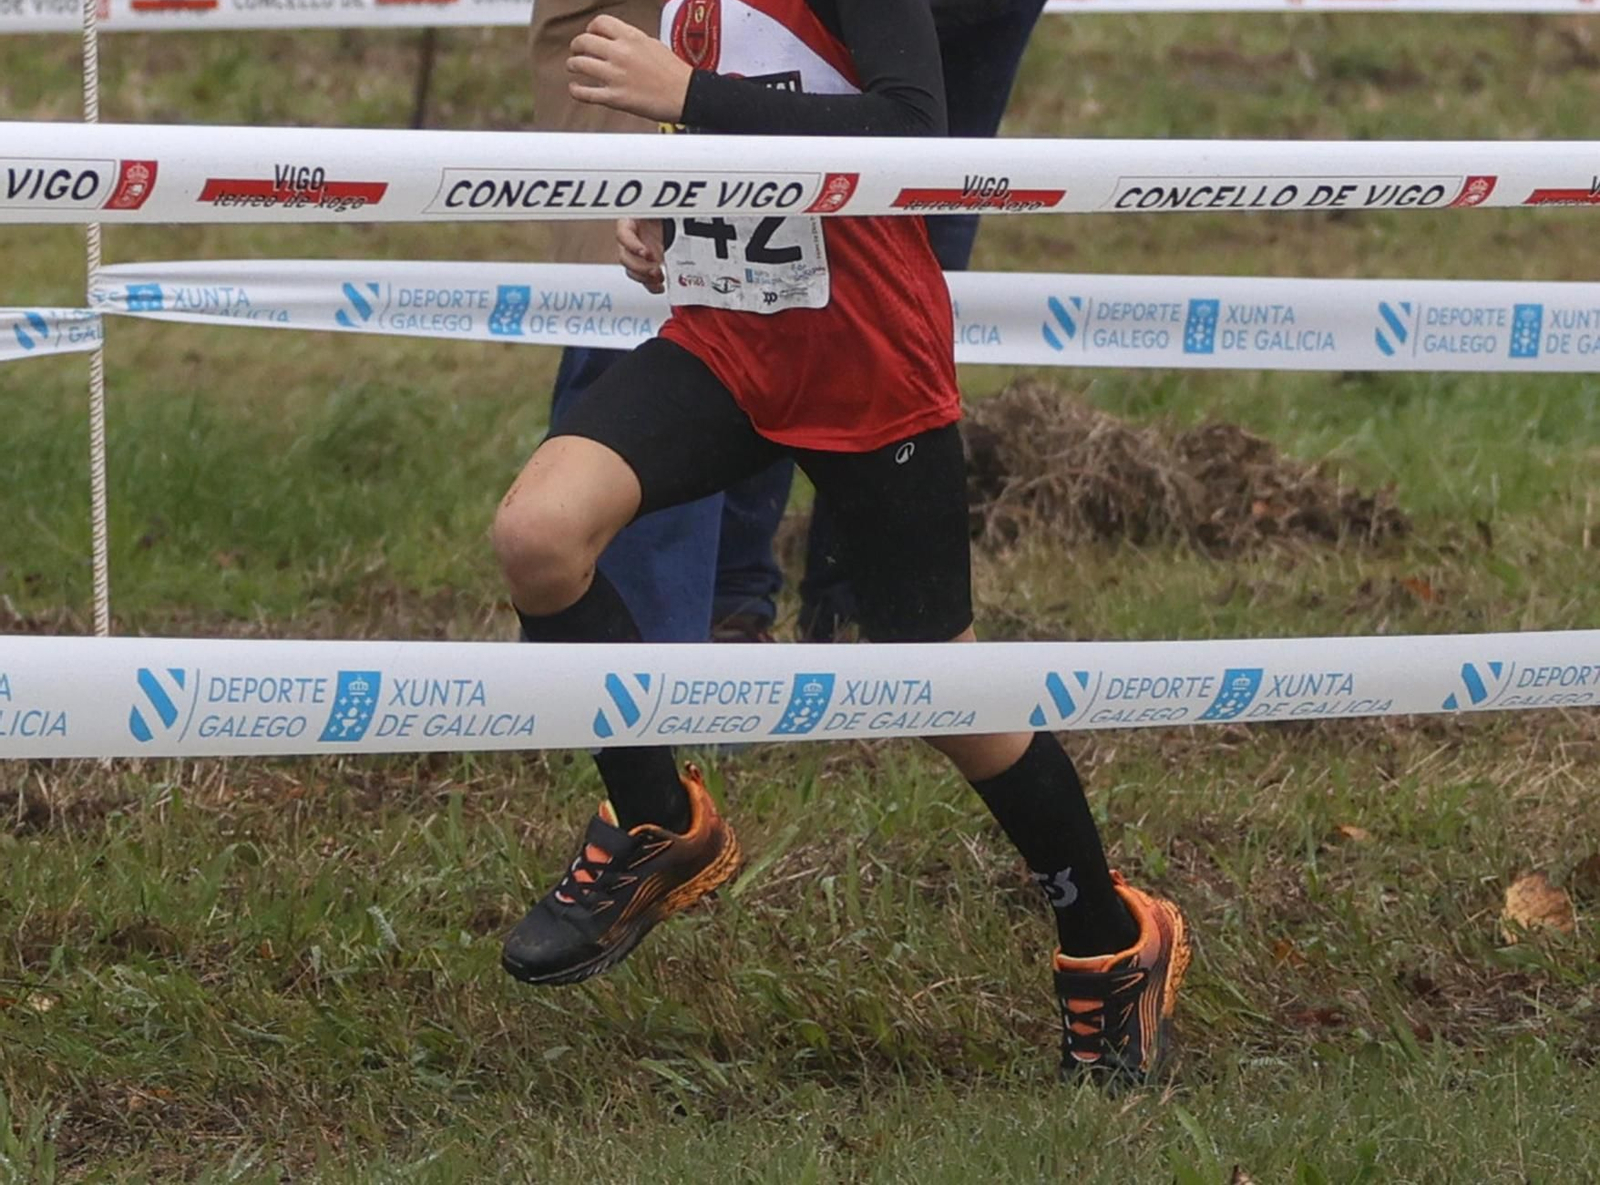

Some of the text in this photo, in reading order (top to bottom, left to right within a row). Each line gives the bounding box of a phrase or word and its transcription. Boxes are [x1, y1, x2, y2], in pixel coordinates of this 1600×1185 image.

[7, 168, 99, 200] VIGO
[445, 179, 804, 209] CONCELLO DE VIGO
[1114, 184, 1446, 208] CONCELLO DE VIGO
[213, 190, 366, 212] terreo de xogo
[173, 286, 250, 308] XUNTA
[398, 288, 613, 312] DEPORTE XUNTA
[391, 313, 652, 336] GALEGO DE GALICIA
[1097, 302, 1295, 325] DEPORTE XUNTA
[1427, 307, 1506, 327] DEPORTE
[1093, 329, 1335, 351] GALEGO DE GALICIA
[1424, 334, 1497, 353] GALEGO
[1546, 333, 1572, 354] DE
[207, 677, 487, 707] DEPORTE XUNTA
[670, 679, 933, 706] DEPORTE XUNTA
[1105, 673, 1356, 700] DEPORTE XUNTA
[656, 710, 978, 735] GALEGO DE GALICIA
[1089, 699, 1395, 724] GALEGO DE GALICIA
[198, 714, 537, 738] GALEGO DE GALICIA
